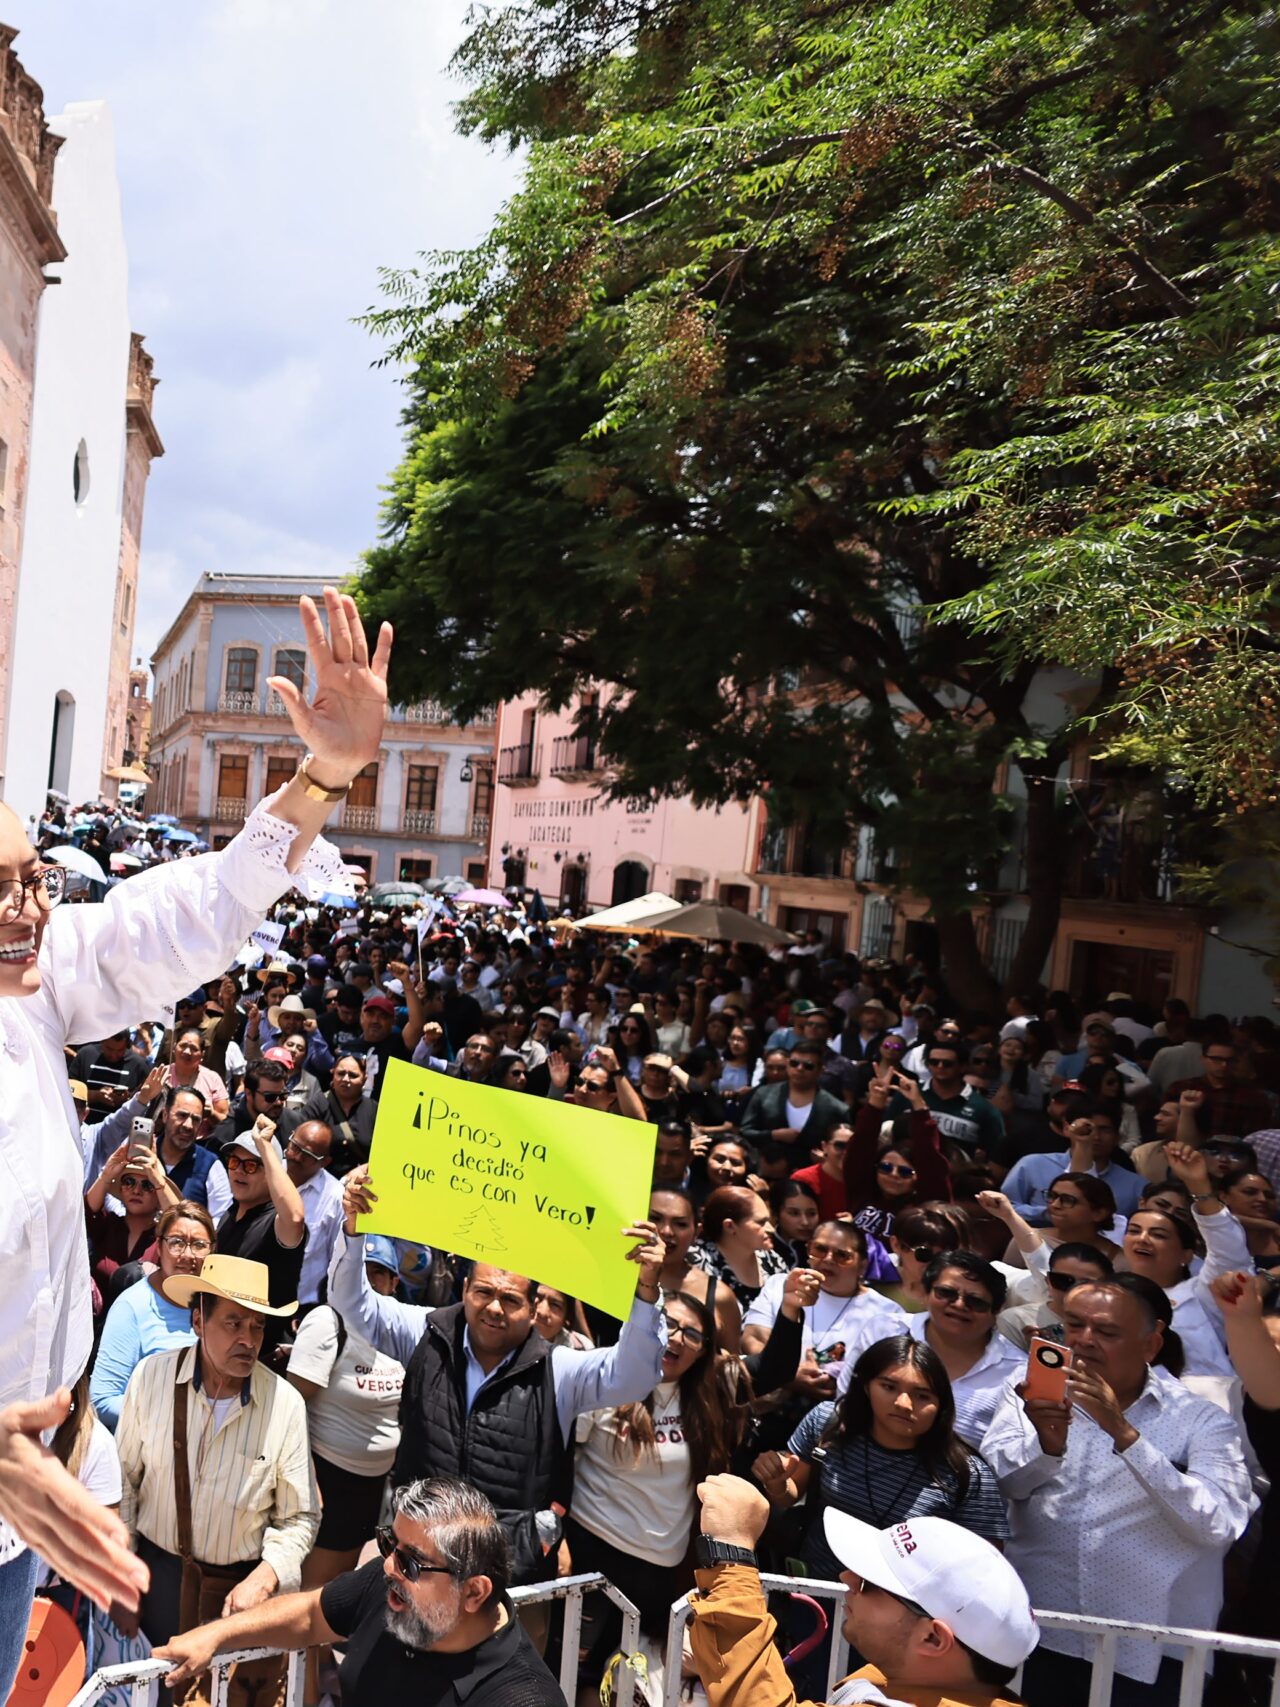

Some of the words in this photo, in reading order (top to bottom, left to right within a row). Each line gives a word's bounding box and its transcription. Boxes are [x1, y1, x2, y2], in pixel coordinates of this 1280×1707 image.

[412, 1090, 502, 1149] ¡Pinos
[519, 1140, 547, 1163] ya
[402, 1162, 436, 1191] que
[449, 1174, 474, 1195] es
[482, 1182, 516, 1205] con
[534, 1194, 597, 1231] Vero!
[355, 1376, 393, 1392] VERO
